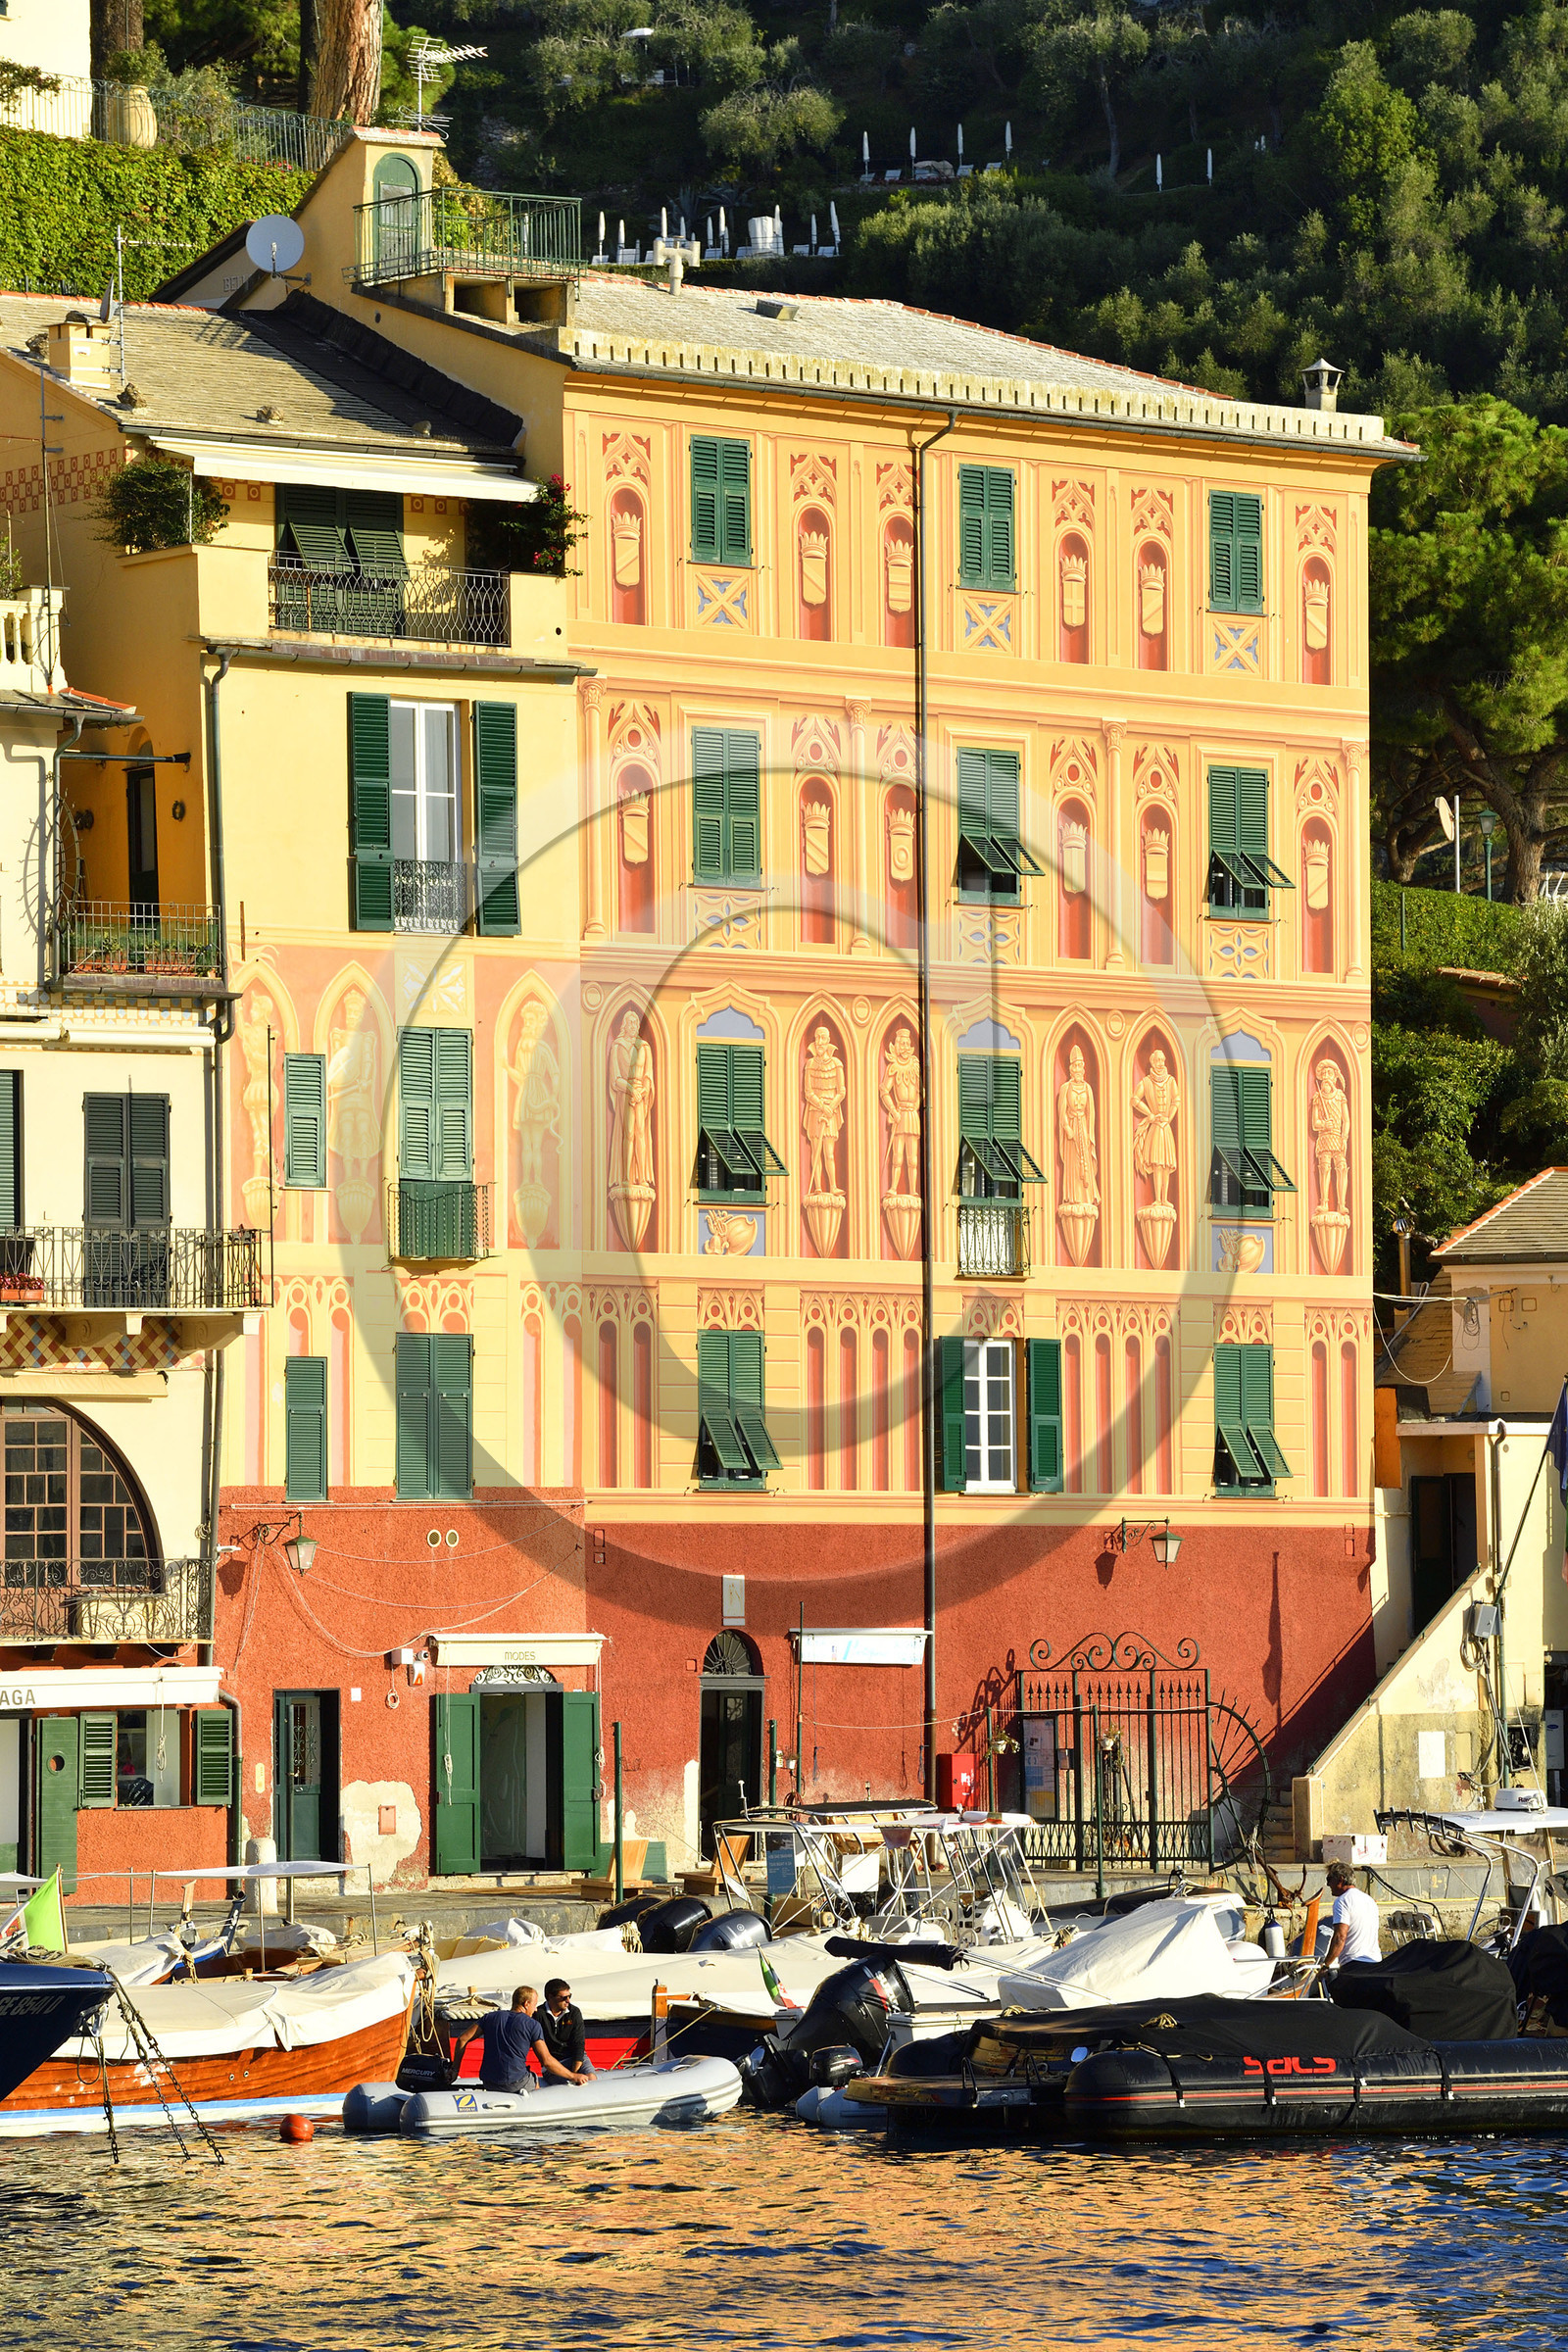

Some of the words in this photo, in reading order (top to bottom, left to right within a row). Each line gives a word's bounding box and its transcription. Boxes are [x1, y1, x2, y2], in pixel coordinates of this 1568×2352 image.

[504, 1651, 536, 1661] MODES
[0, 1689, 36, 1705] AGA
[401, 2067, 436, 2077] MERCURY
